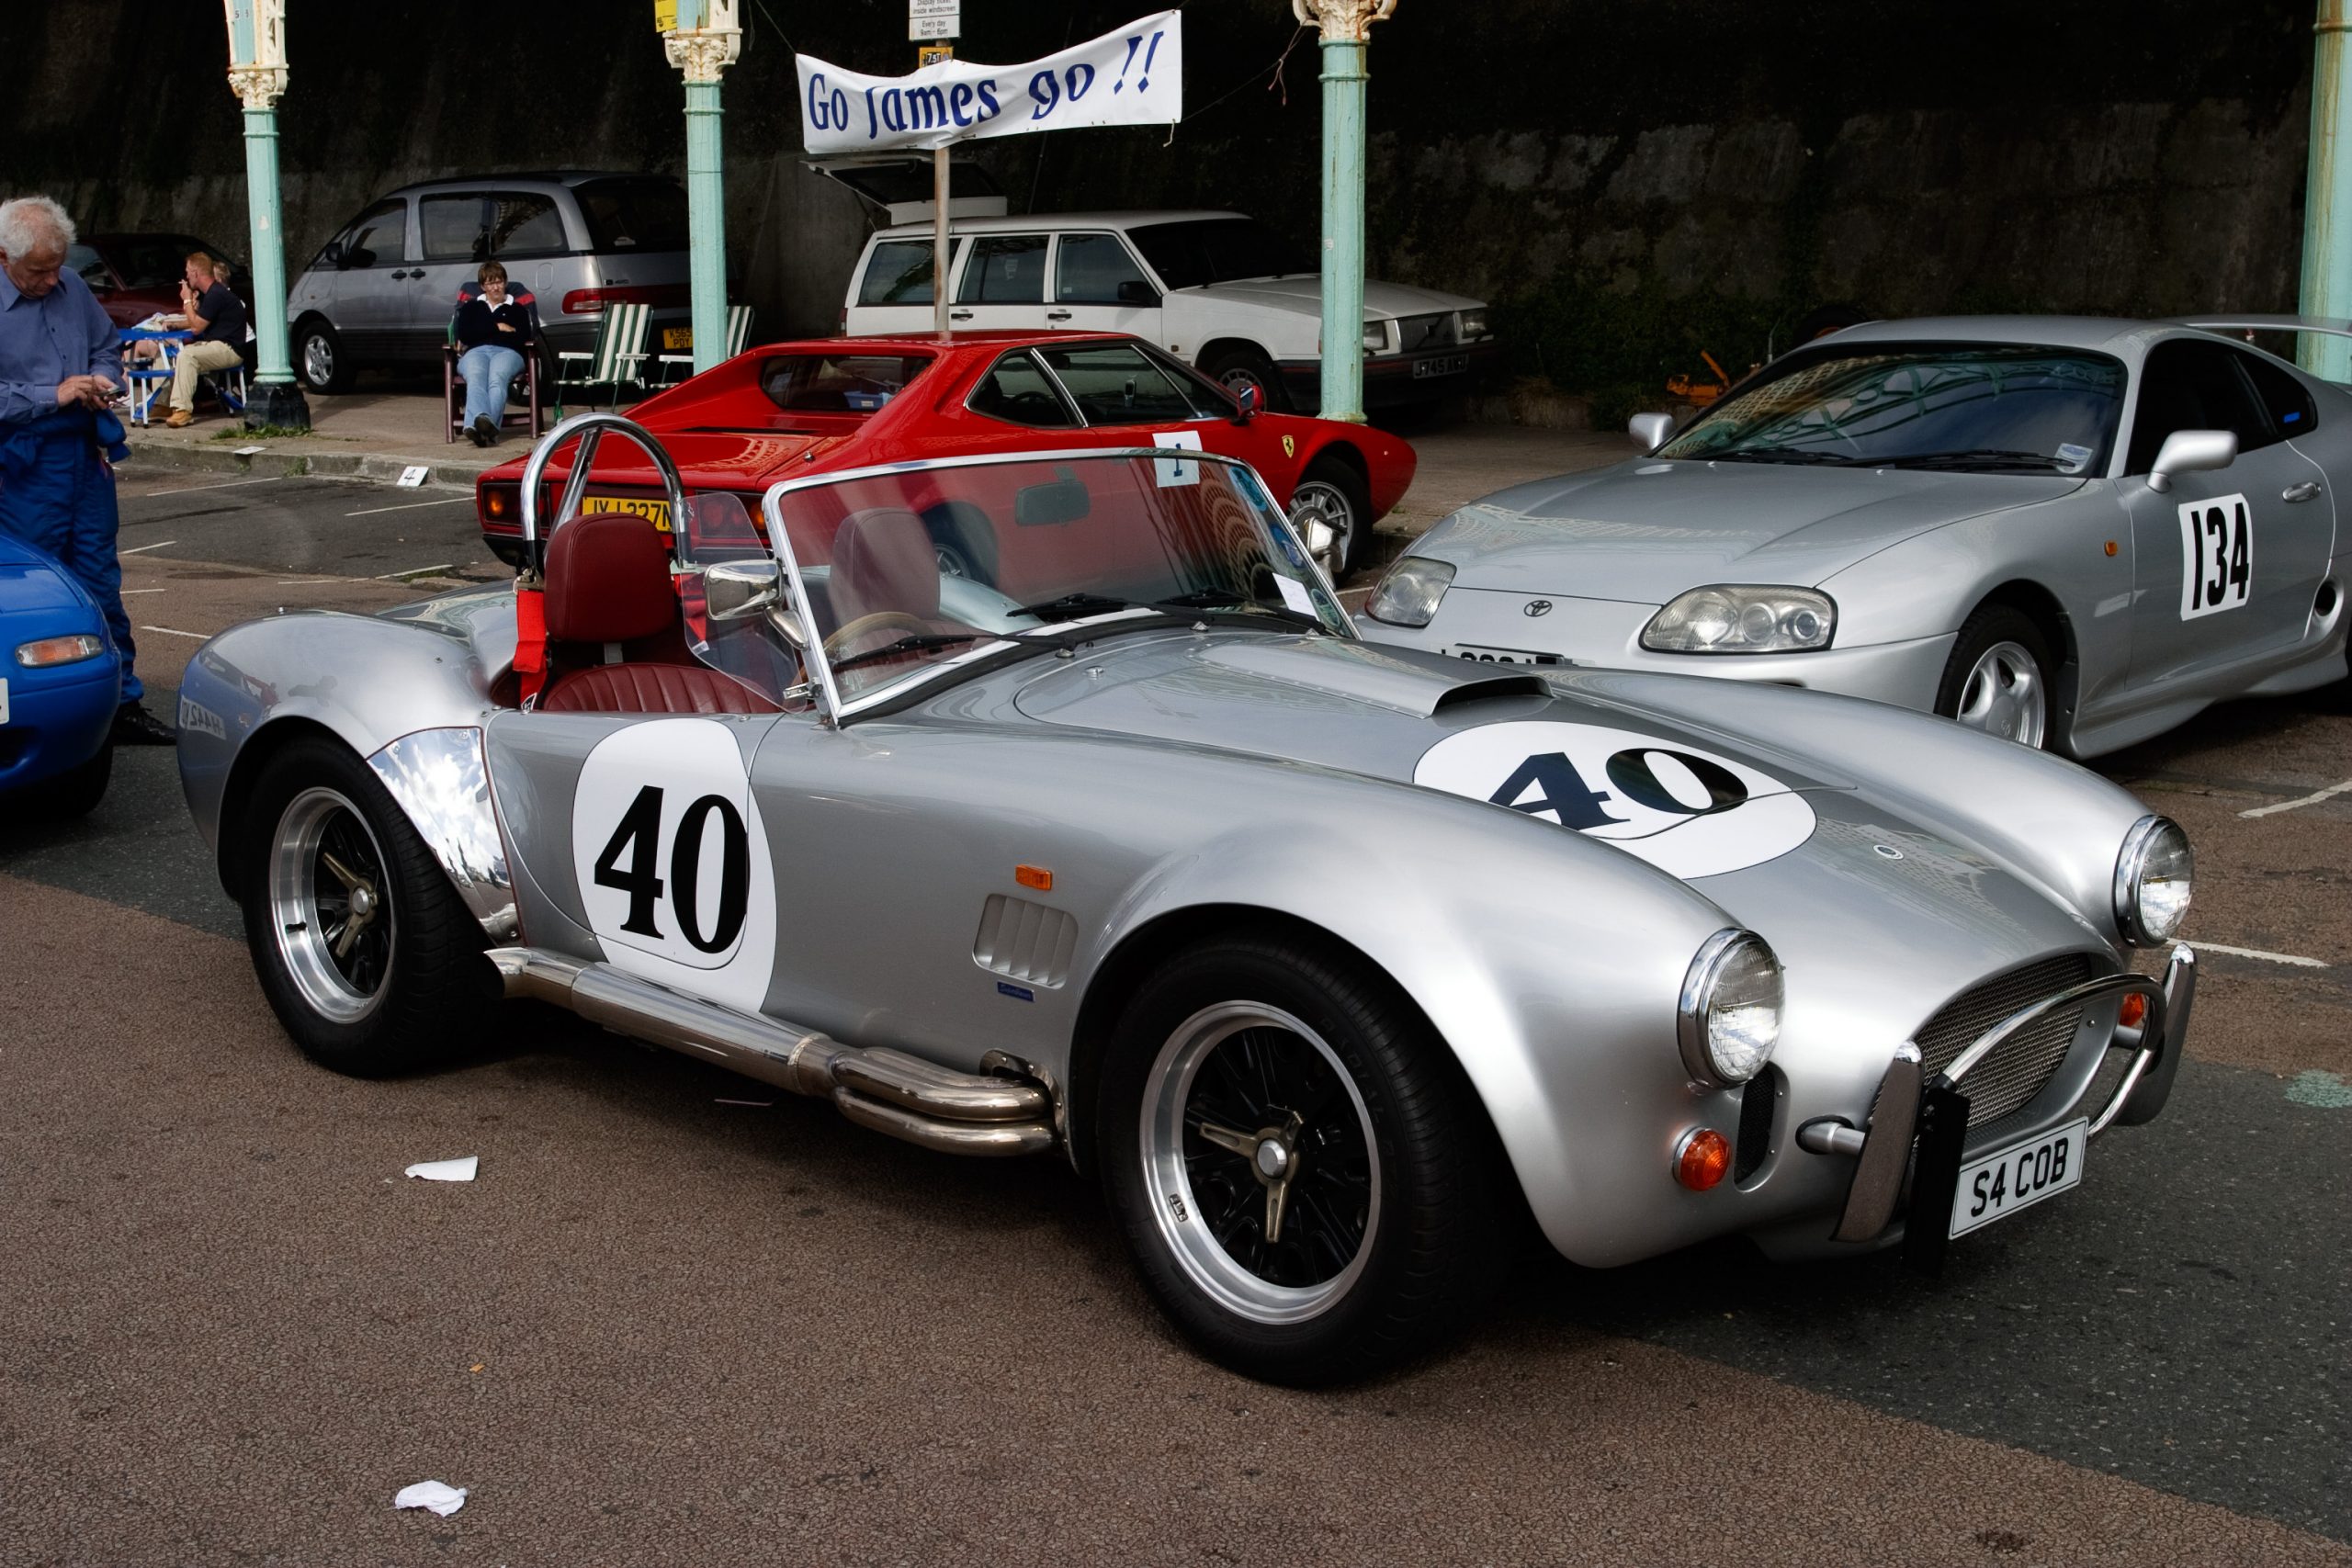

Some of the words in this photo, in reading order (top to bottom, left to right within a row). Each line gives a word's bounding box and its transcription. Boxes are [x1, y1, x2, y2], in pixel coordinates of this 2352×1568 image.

[808, 73, 849, 131] Go
[865, 78, 1001, 140] James
[1028, 63, 1095, 120] go
[1114, 30, 1165, 96] !!
[1416, 359, 1445, 377] J745
[404, 468, 416, 486] 4
[2190, 502, 2250, 611] 134
[1487, 747, 1749, 831] 40
[594, 784, 750, 954] 40
[1971, 1168, 2007, 1218] S4
[2015, 1137, 2070, 1200] COB
